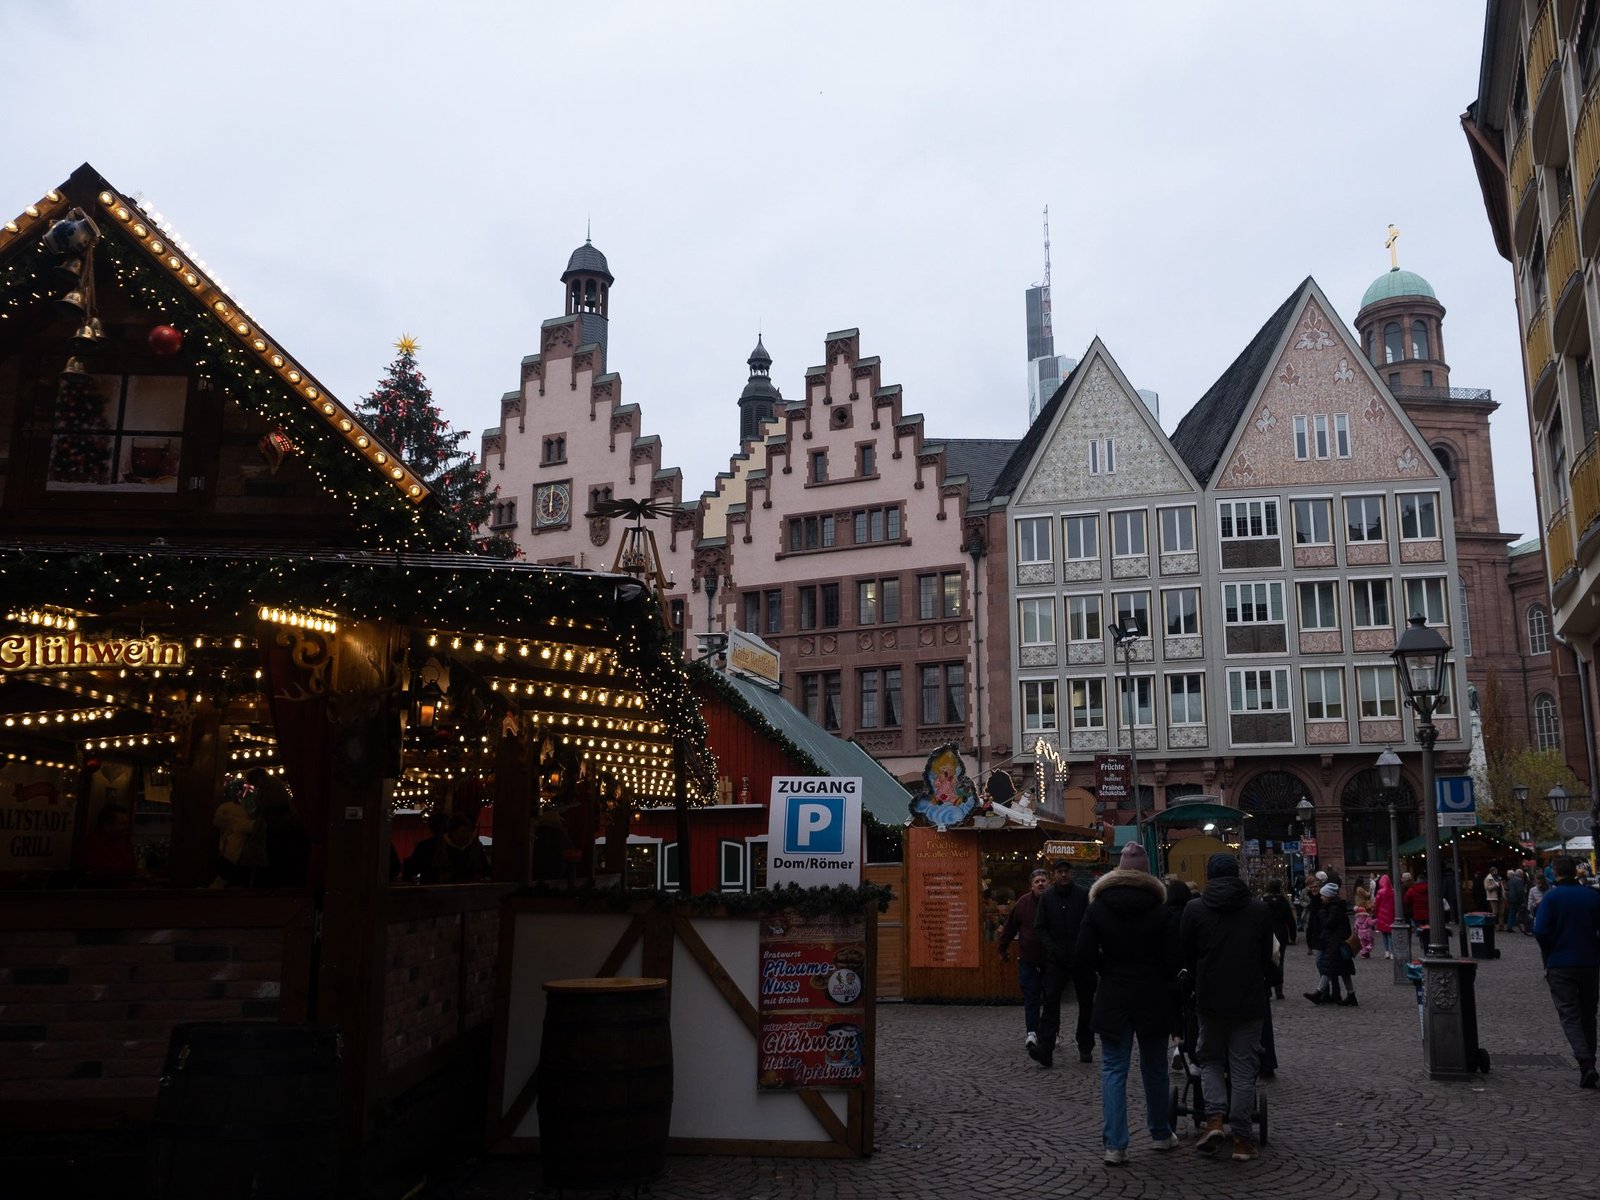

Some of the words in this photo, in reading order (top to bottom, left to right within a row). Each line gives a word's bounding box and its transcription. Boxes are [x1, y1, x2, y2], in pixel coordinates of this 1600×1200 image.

[0, 633, 183, 669] Glühwein
[1100, 763, 1125, 771] Früchte
[778, 781, 856, 793] ZUGANG
[1442, 780, 1472, 810] U
[797, 803, 832, 846] P
[10, 835, 54, 857] GRILL
[1046, 843, 1075, 855] Ananas
[773, 857, 854, 869] Dom/Römer
[763, 950, 801, 959] Bratwurst
[763, 959, 837, 977] Pflaume-
[762, 976, 800, 994] Nuss
[763, 997, 777, 1005] mit
[778, 996, 809, 1005] Brötchen
[762, 1030, 858, 1054] Glühwein
[762, 1055, 803, 1070] Heißer
[794, 1062, 862, 1085] Apfelwein
